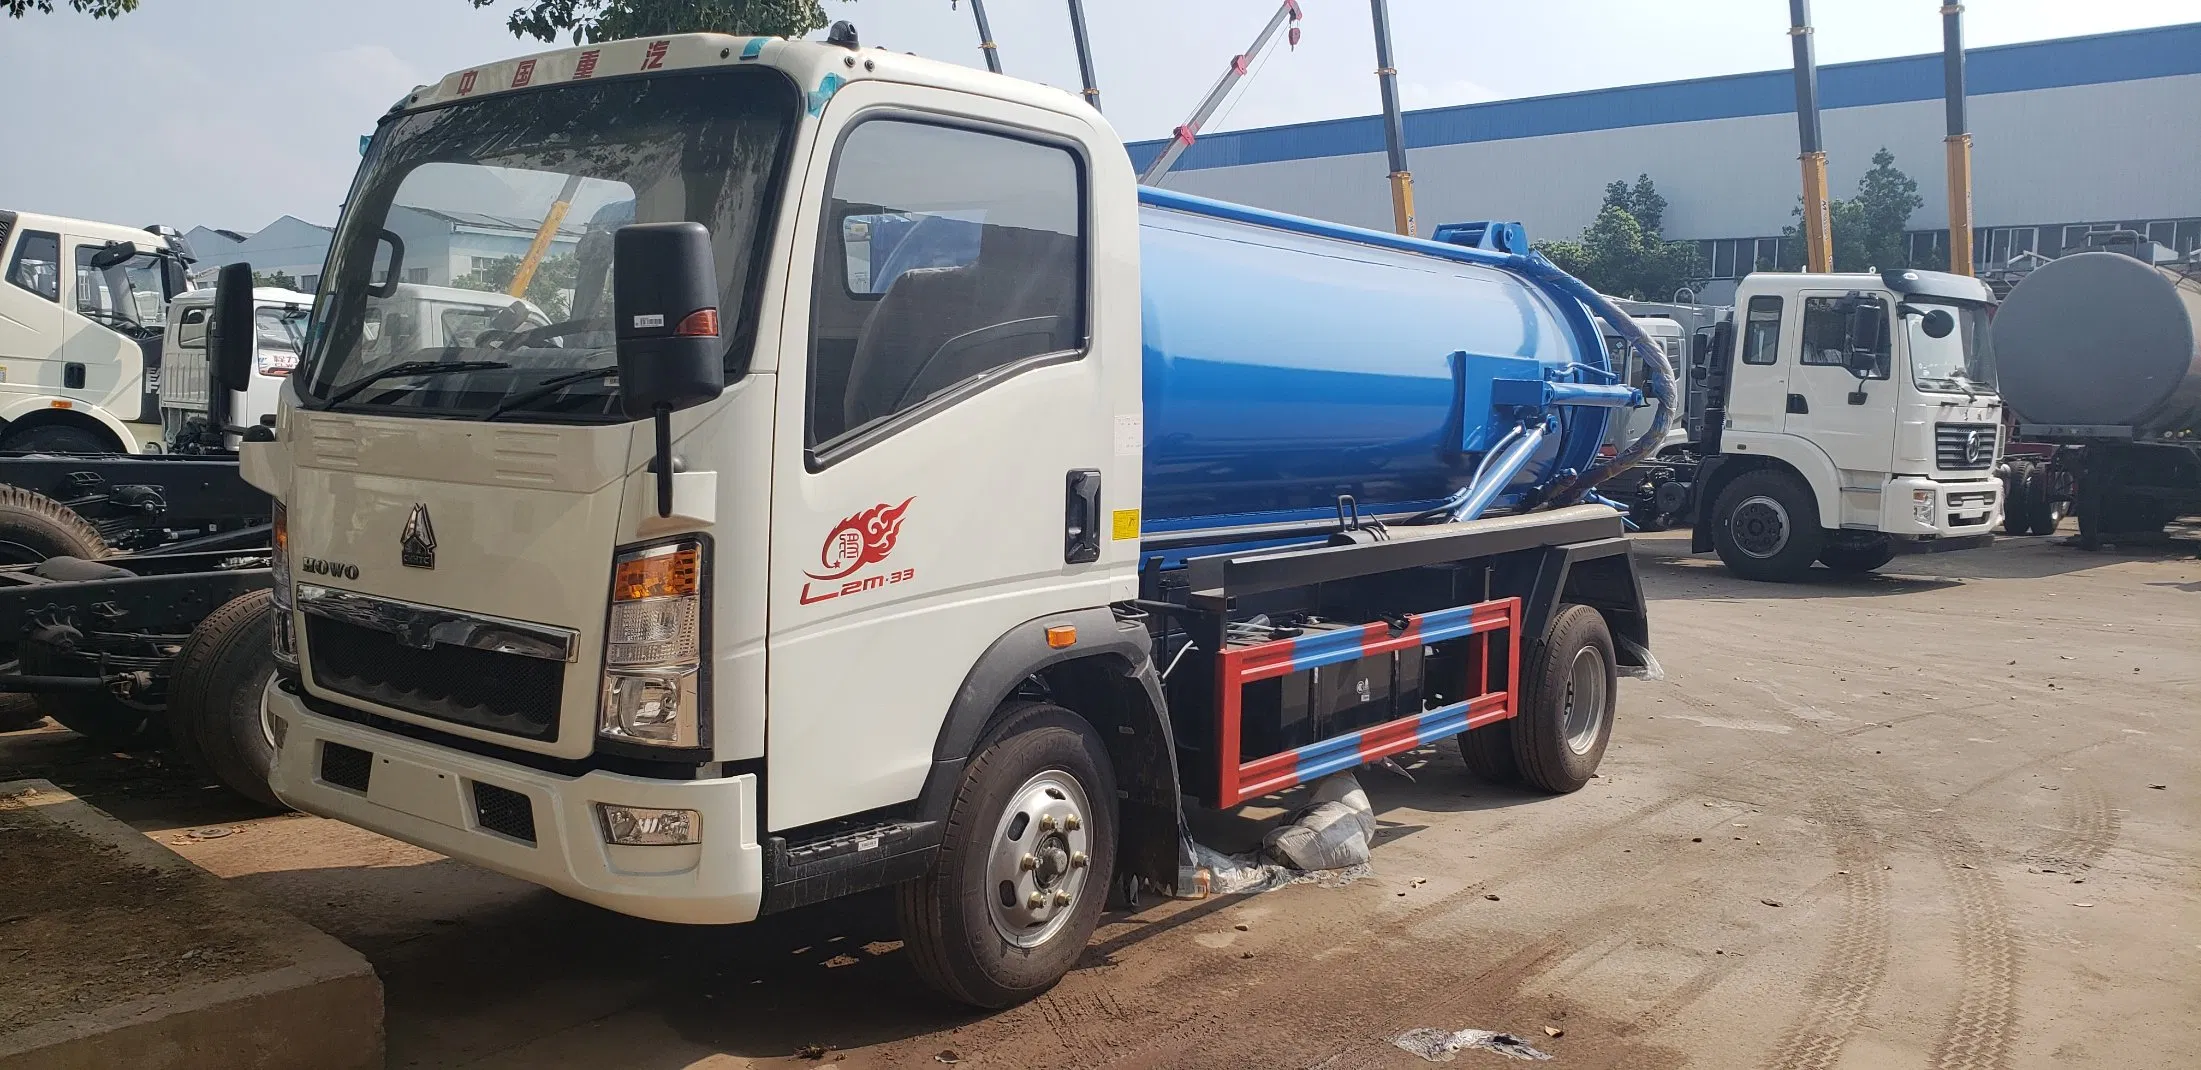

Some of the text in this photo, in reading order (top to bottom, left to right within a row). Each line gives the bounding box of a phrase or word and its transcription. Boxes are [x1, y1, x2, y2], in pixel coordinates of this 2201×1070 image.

[456, 40, 671, 96] 中国重汽
[302, 556, 360, 580] HOWO
